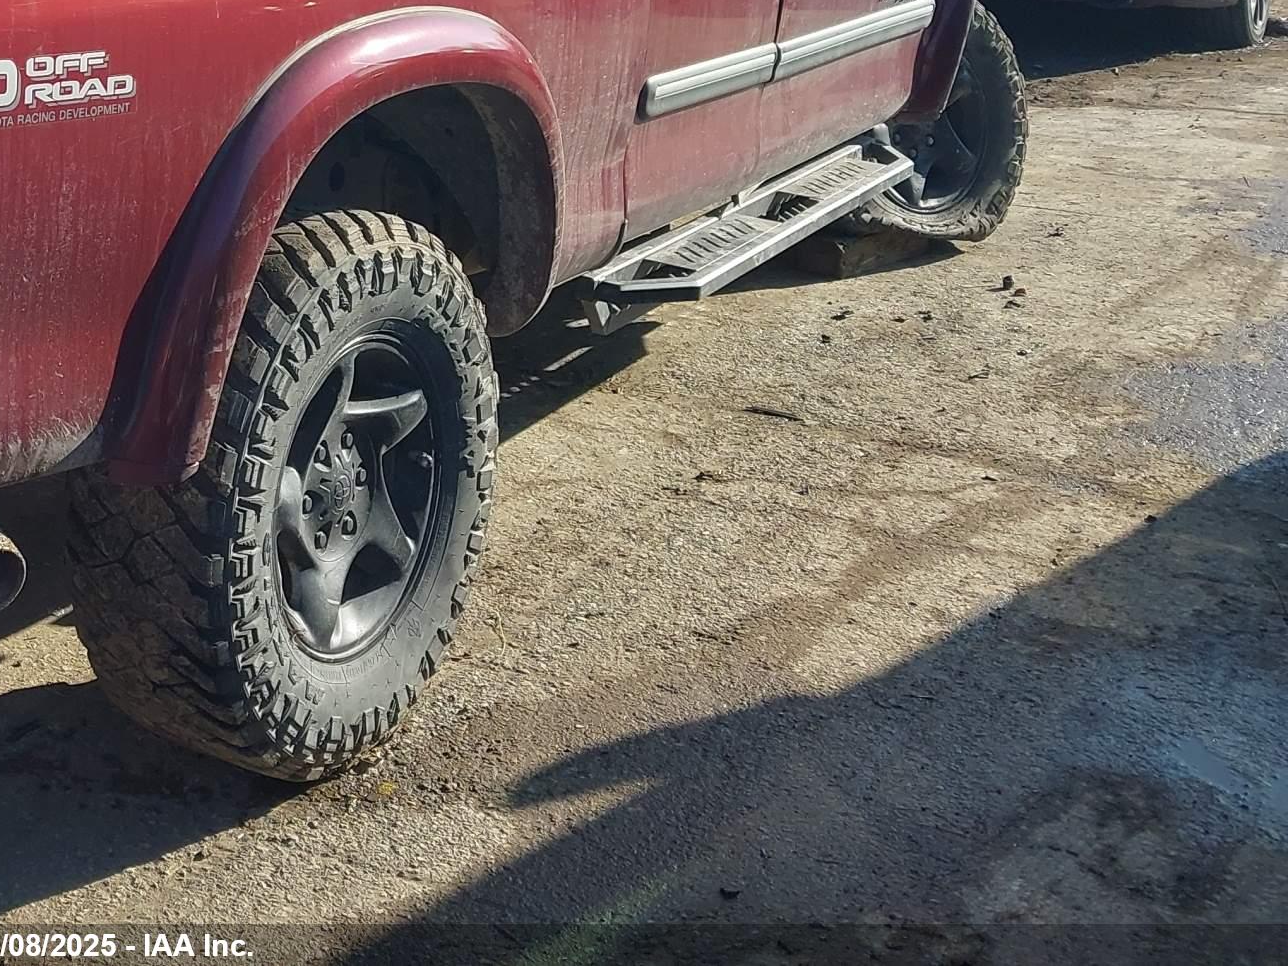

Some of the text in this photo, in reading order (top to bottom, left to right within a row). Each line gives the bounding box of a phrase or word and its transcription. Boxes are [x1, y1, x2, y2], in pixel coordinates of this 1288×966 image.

[25, 51, 109, 78] OFF
[24, 75, 136, 108] ROAD
[17, 111, 56, 125] RACING
[59, 101, 130, 120] DEVELOPMENT
